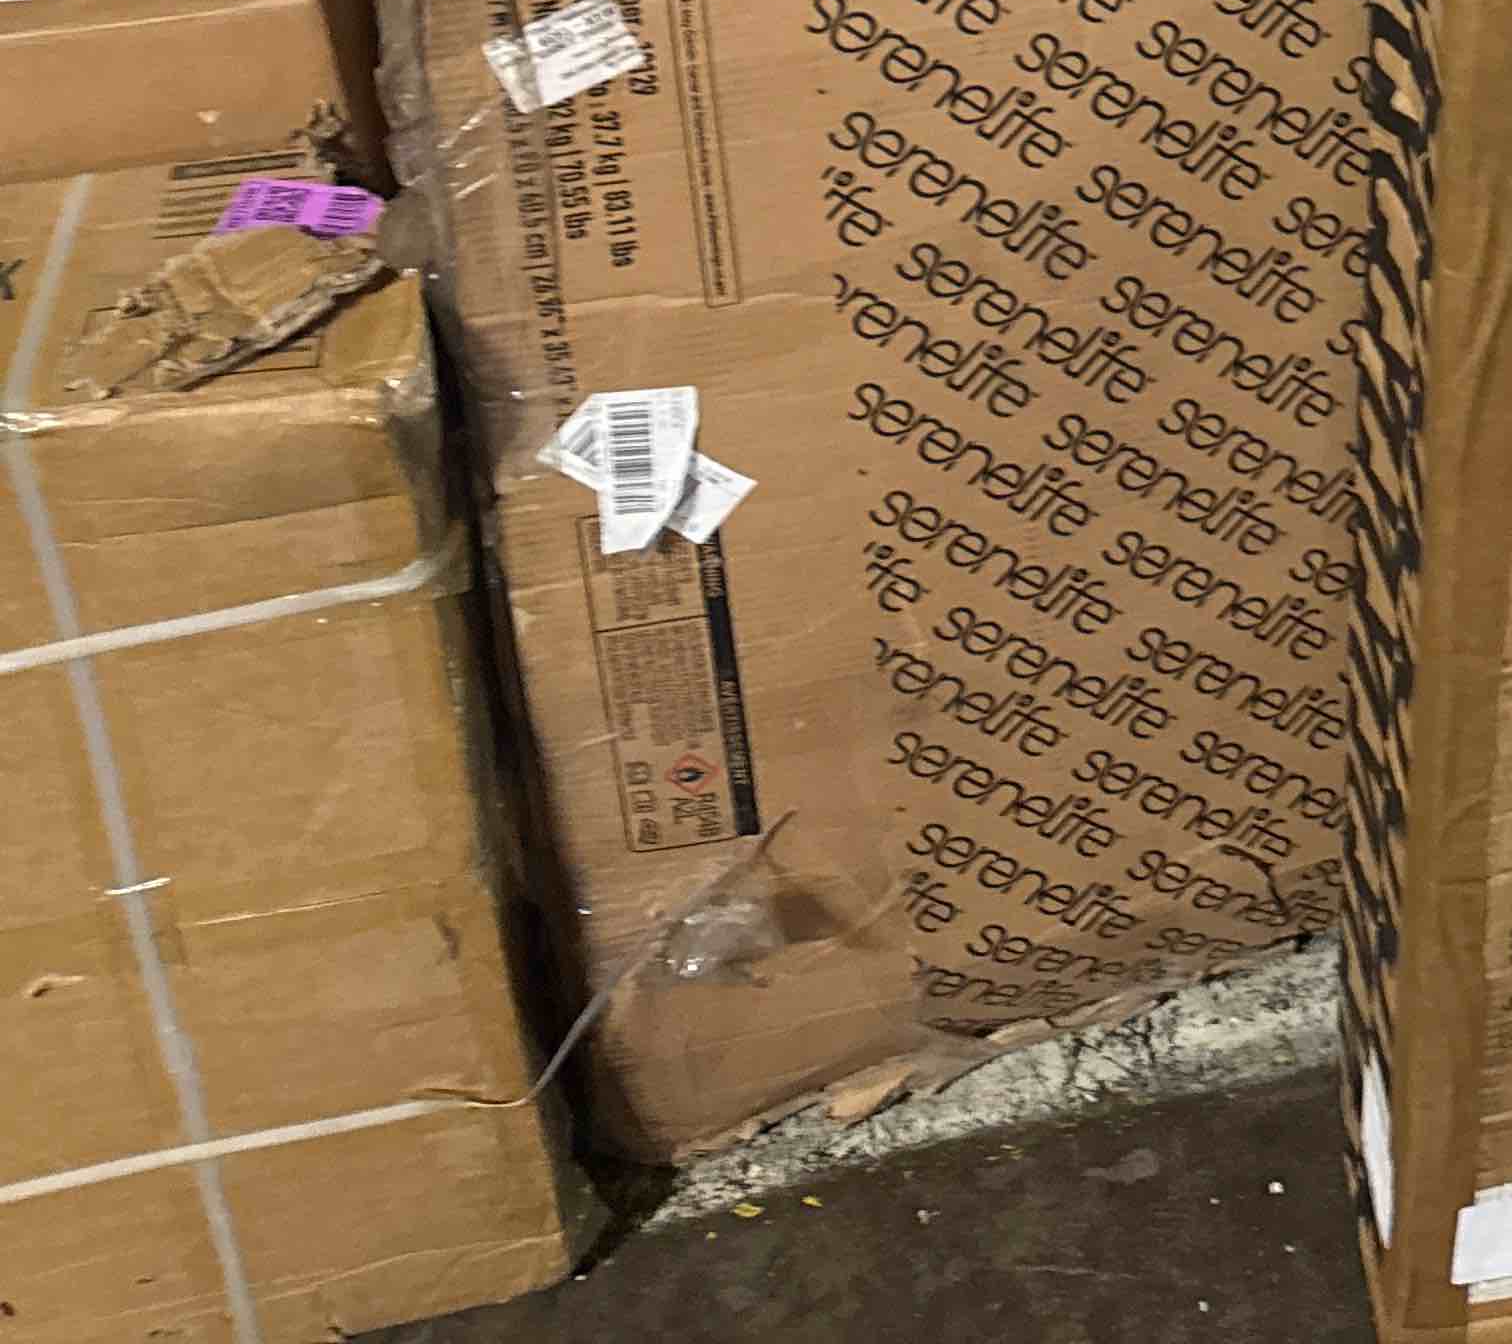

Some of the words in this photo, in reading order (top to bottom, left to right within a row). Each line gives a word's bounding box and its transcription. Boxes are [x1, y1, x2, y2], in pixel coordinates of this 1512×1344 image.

[1014, 33, 1273, 200] serenelife
[829, 112, 1096, 280] serenelife
[1076, 164, 1326, 323] serenelife
[896, 243, 1156, 402] serenelife
[1100, 276, 1345, 427] serenelife
[848, 382, 1099, 537] serenelife
[1043, 414, 1287, 556] serenelife
[869, 490, 1124, 635] serenelife
[1103, 530, 1337, 661] serenelife
[934, 607, 1177, 740] serenelife
[1126, 626, 1348, 751] serenelife
[888, 731, 1127, 858] serenelife
[1072, 750, 1302, 860] serenelife
[906, 823, 1145, 940] serenelife
